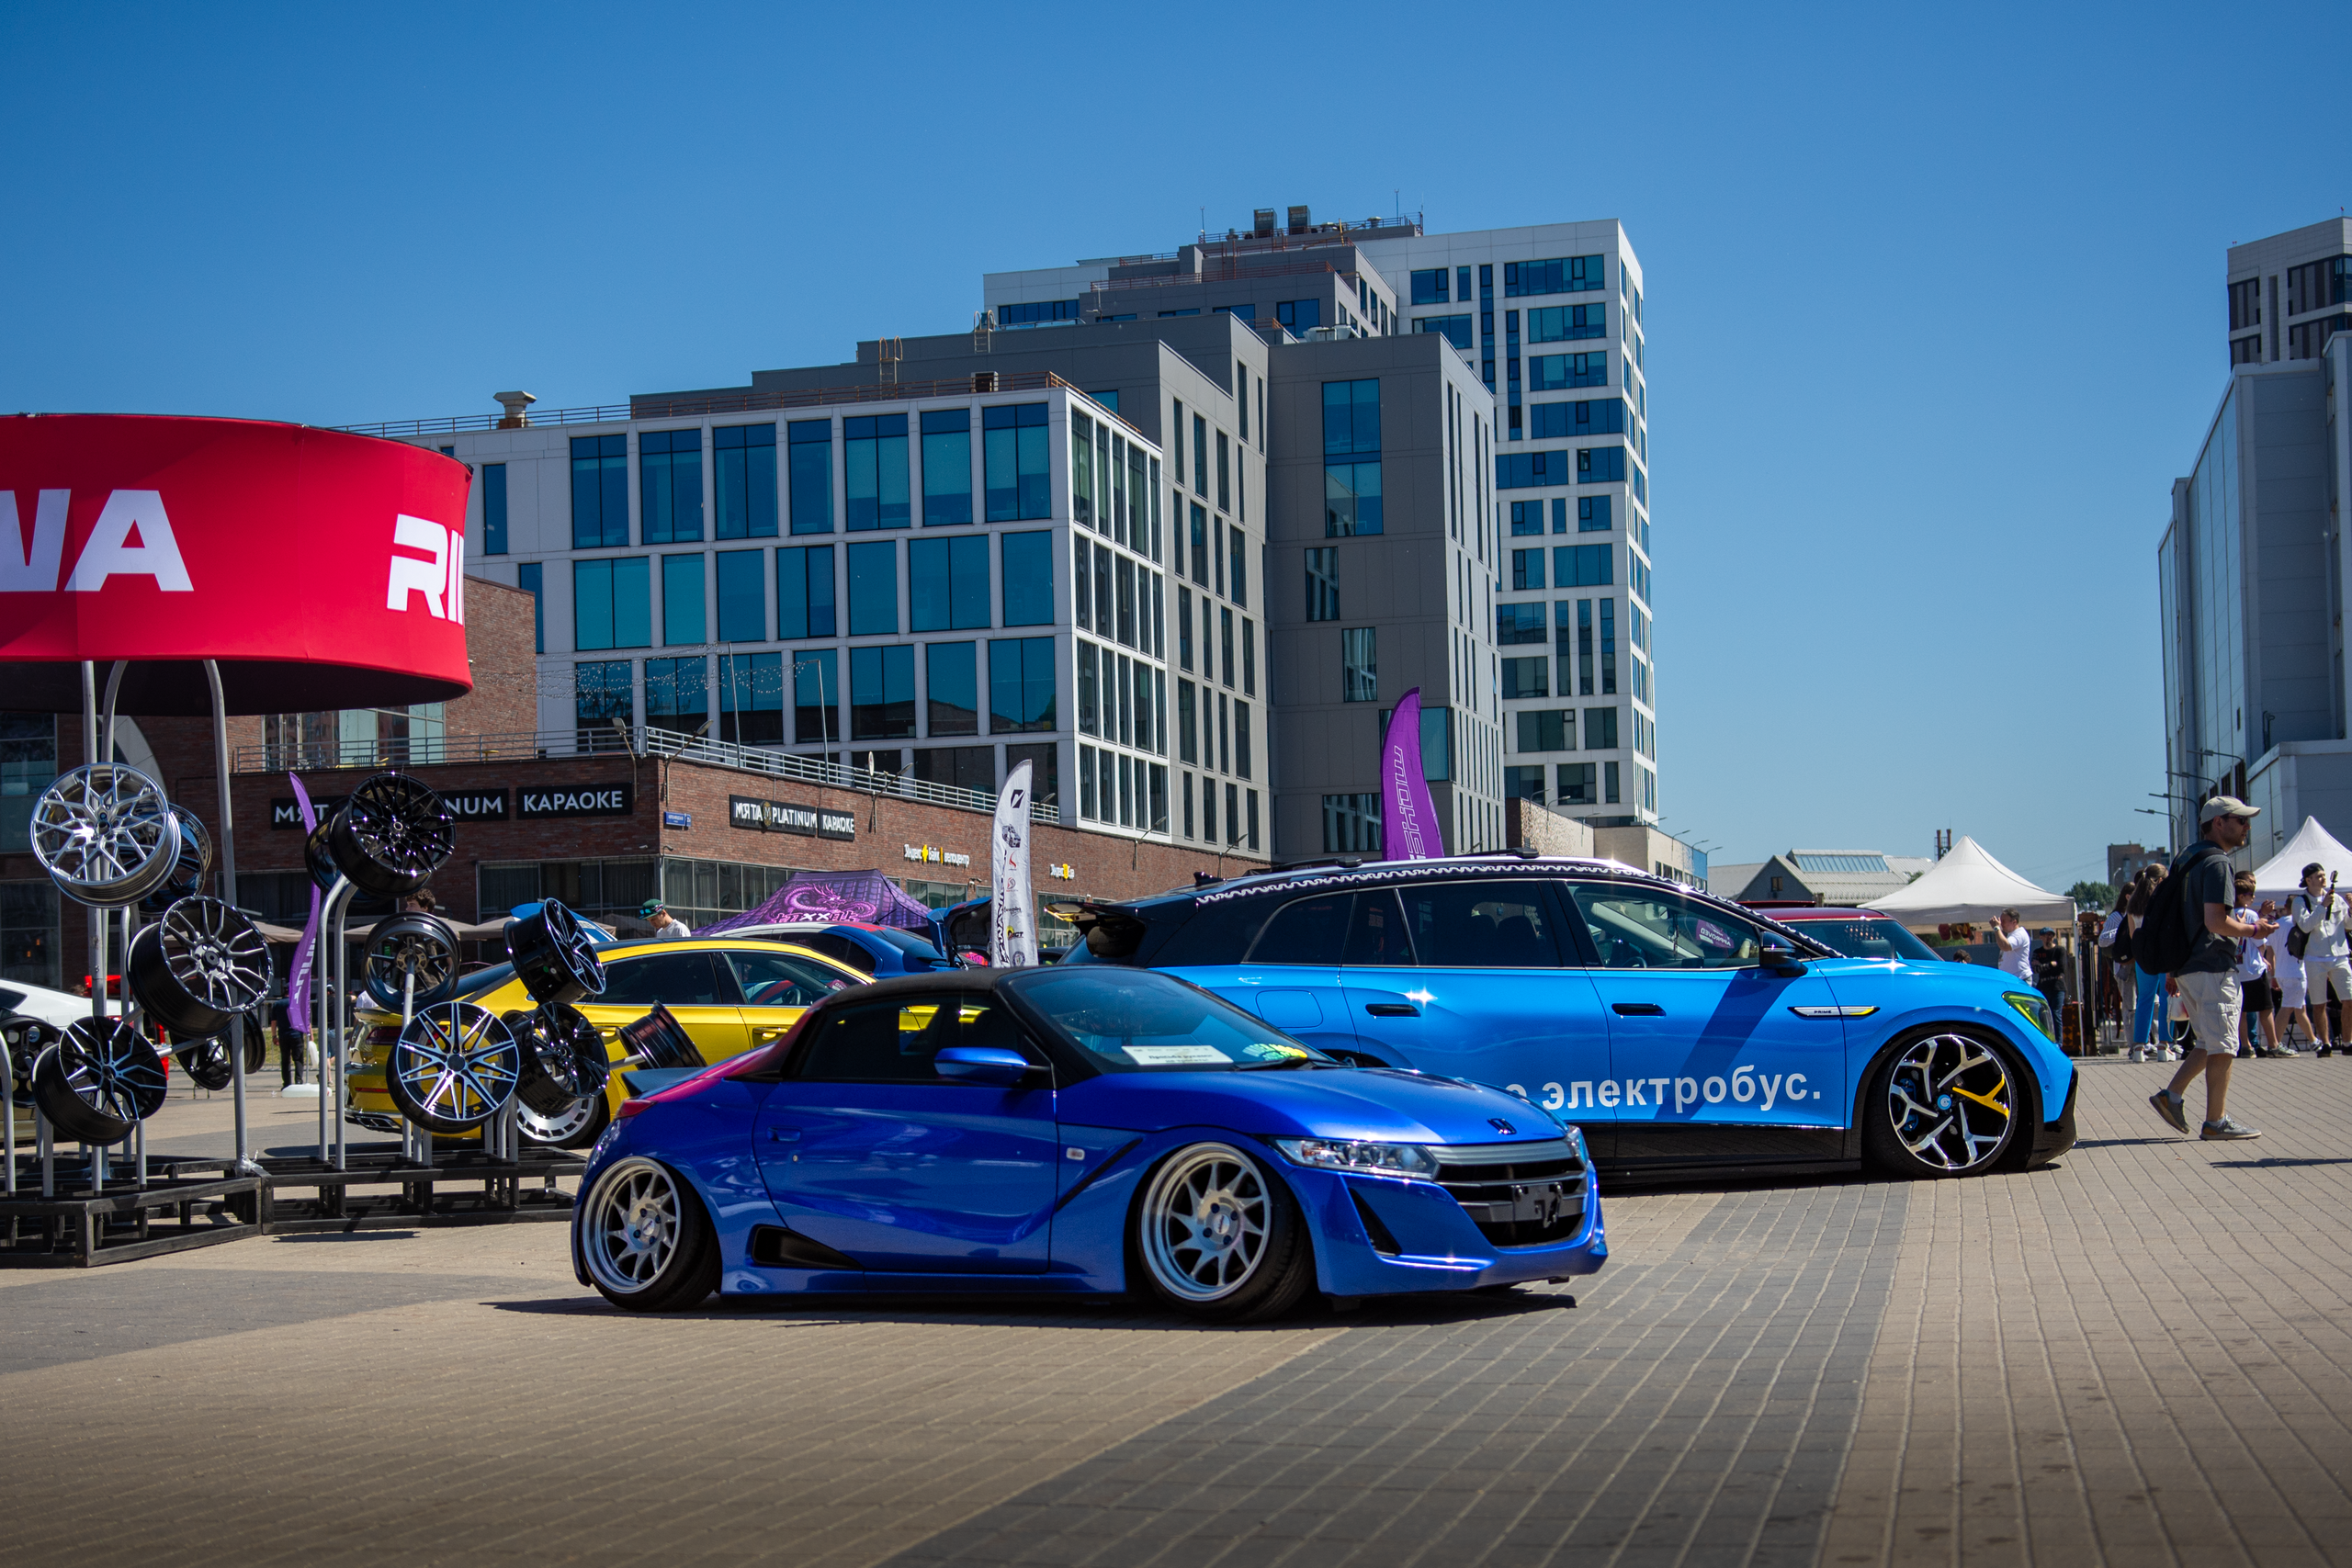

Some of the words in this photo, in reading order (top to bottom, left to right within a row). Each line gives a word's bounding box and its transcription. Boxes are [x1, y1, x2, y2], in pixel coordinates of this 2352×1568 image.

[523, 791, 623, 812] КАРАОКЕ
[735, 802, 763, 822] МЯТА
[772, 807, 818, 829] PLATINUM
[822, 815, 854, 833] КАРАОКЕ
[1542, 1065, 1820, 1113] электробус.
